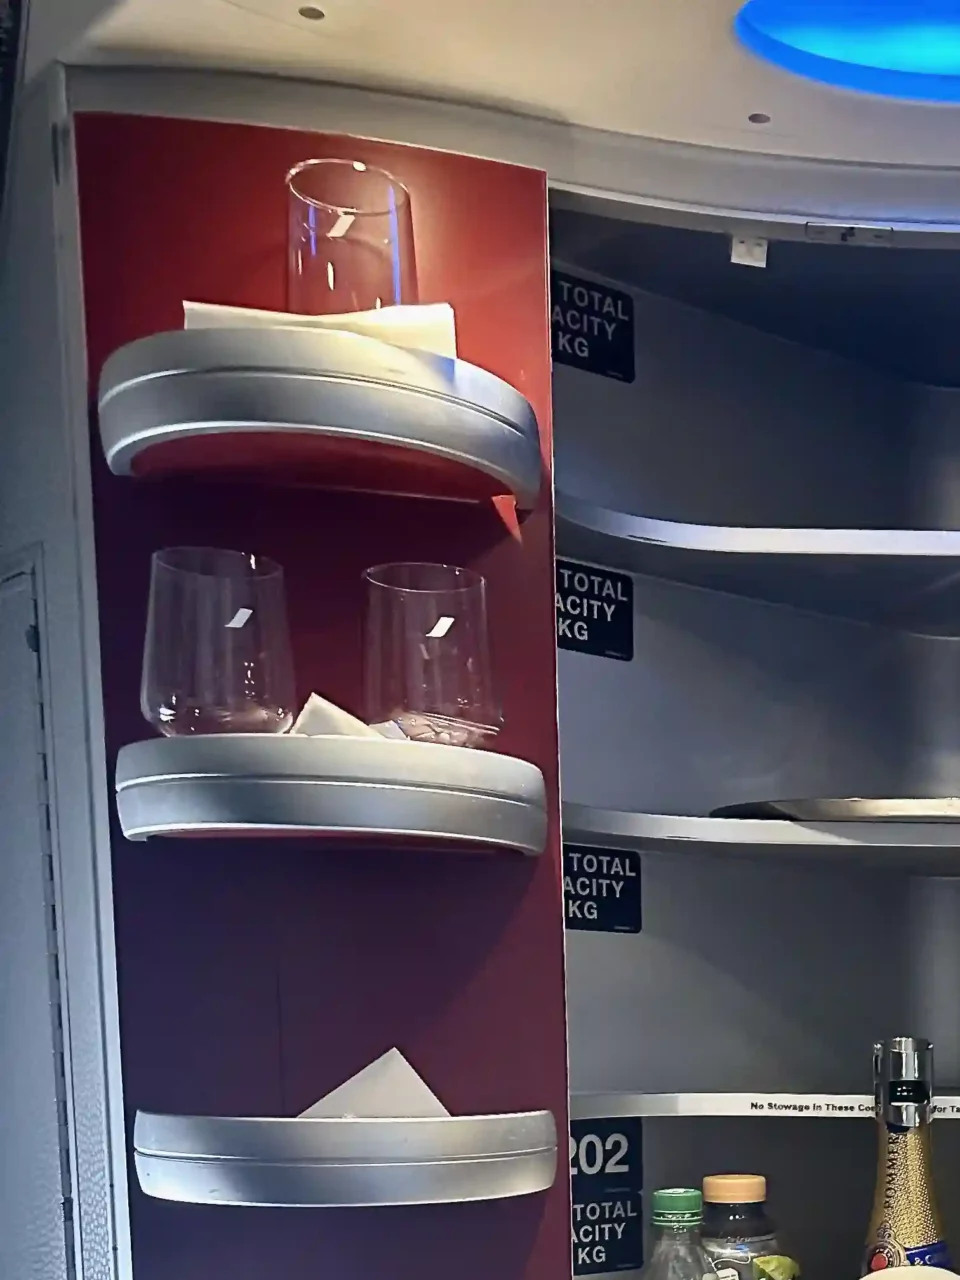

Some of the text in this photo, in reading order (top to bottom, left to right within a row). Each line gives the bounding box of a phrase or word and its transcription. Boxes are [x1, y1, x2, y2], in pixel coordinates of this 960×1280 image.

[558, 280, 629, 321] TOTAL
[558, 331, 589, 357] KG
[559, 568, 629, 601] TOTAL
[558, 617, 588, 641] KG
[568, 852, 636, 877] TOTAL
[568, 900, 598, 919] KG
[750, 1102, 765, 1110] No
[767, 1102, 811, 1113] Stowage
[825, 1103, 856, 1112] These
[572, 1200, 638, 1221] TOTAL
[577, 1246, 606, 1265] KG
